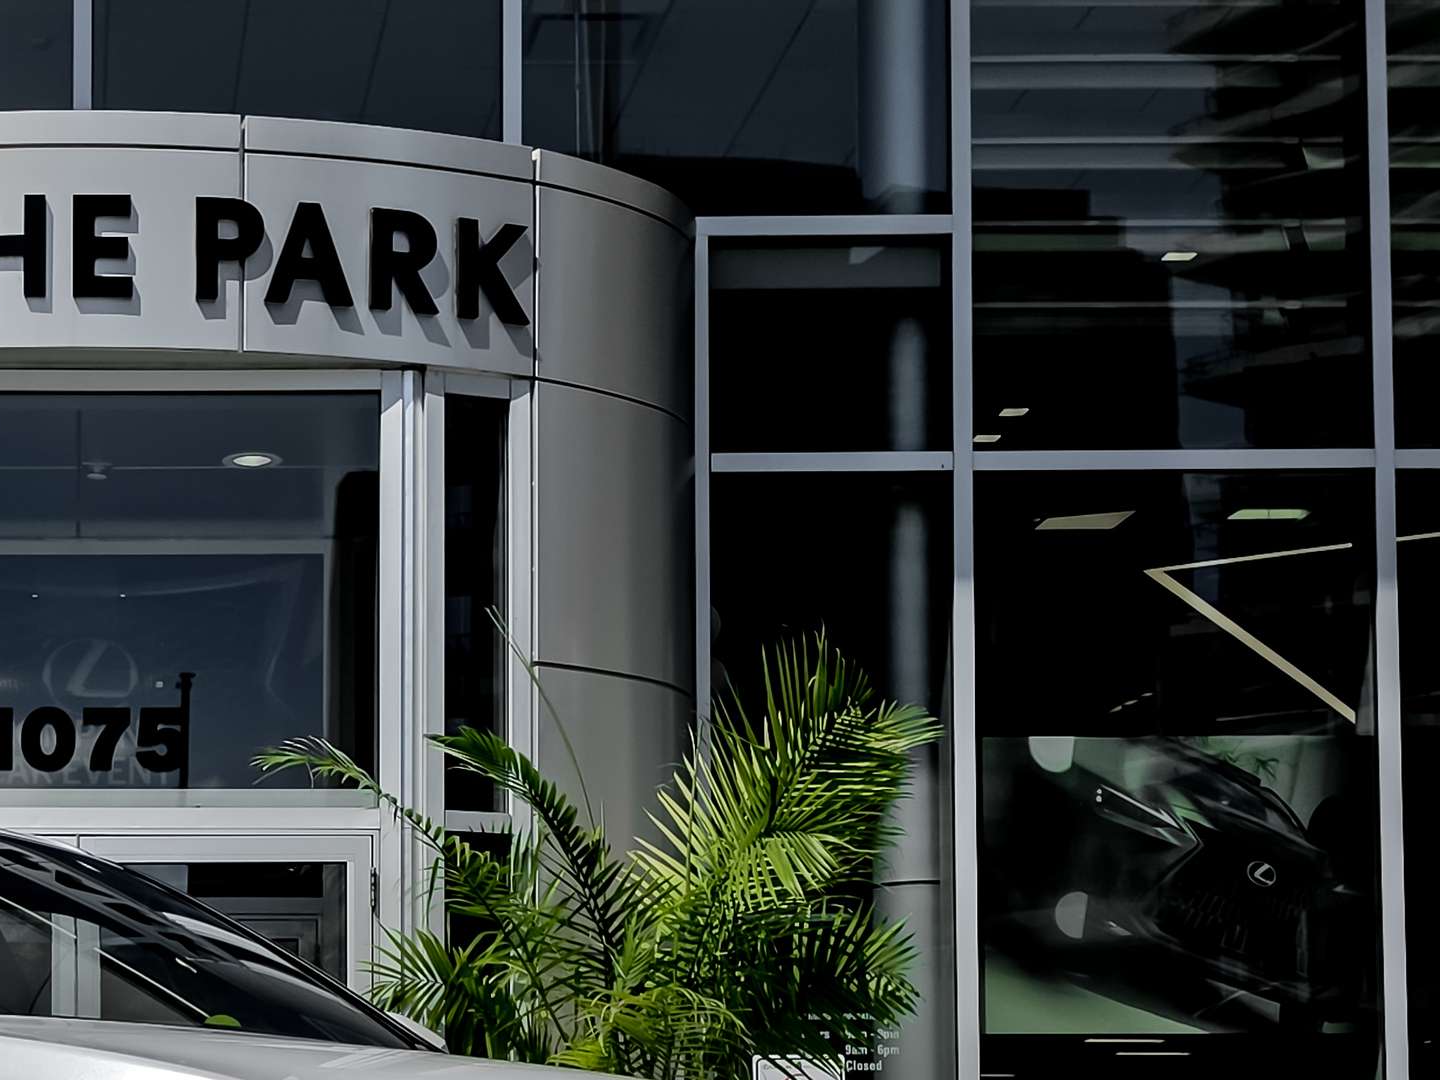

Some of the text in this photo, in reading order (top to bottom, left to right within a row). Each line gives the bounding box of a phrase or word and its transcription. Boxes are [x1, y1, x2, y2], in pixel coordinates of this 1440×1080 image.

[195, 197, 531, 327] PARK
[877, 1044, 901, 1057] 6pm
[845, 1060, 883, 1072] Closed
